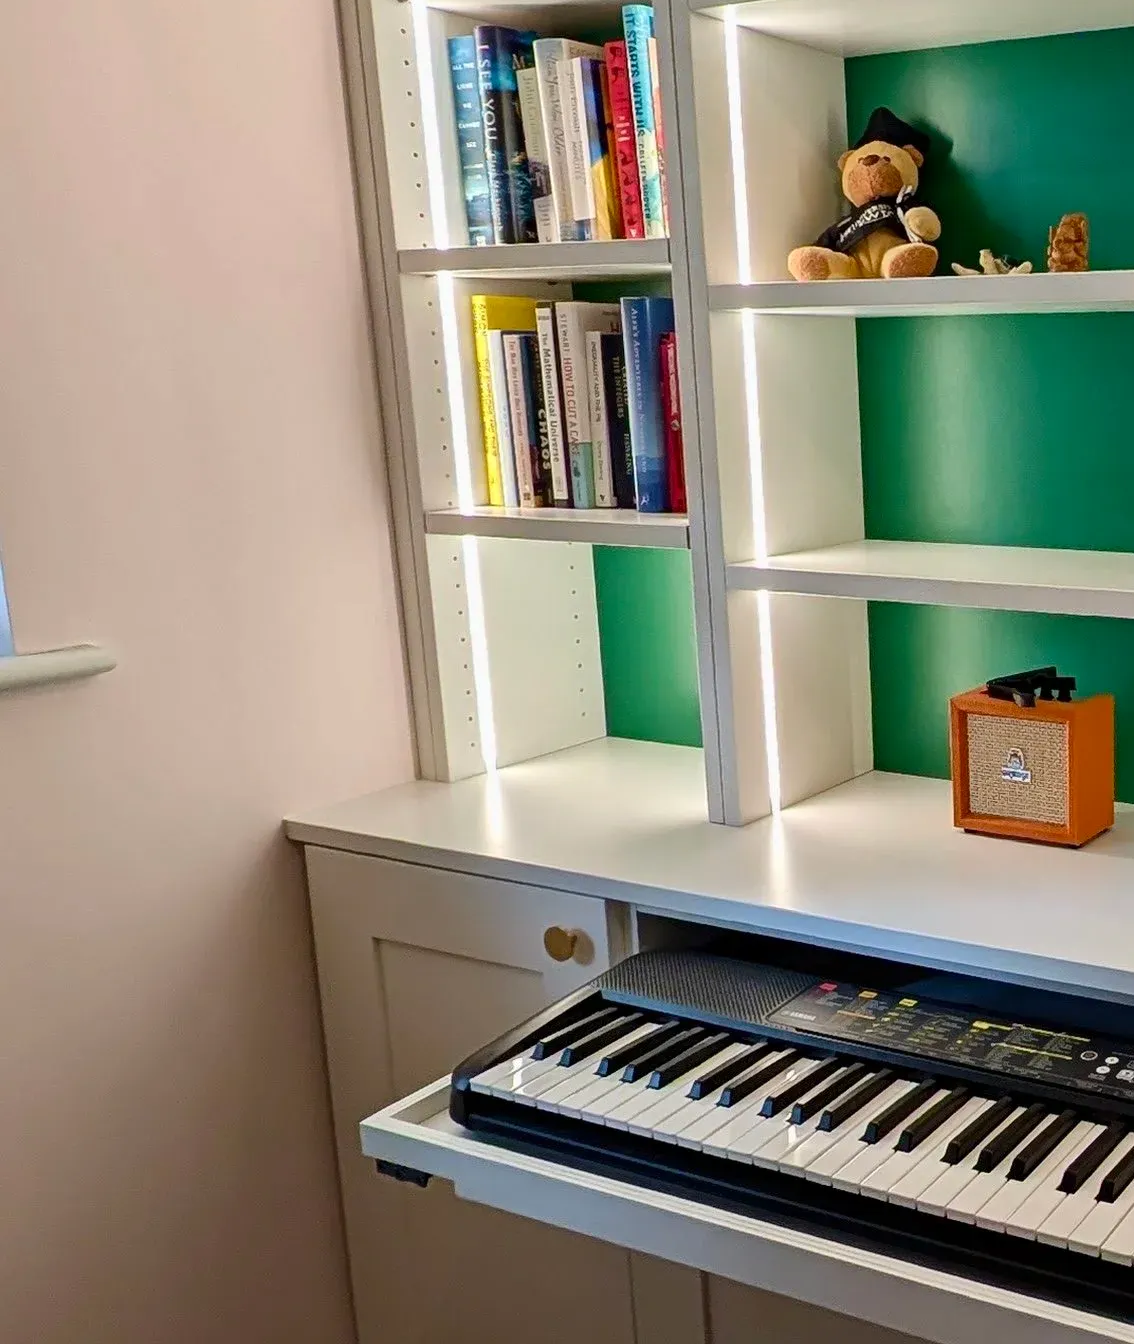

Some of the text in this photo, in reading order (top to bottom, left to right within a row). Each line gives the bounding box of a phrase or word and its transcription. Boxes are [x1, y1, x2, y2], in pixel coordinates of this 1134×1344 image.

[477, 59, 491, 91] SEE
[624, 13, 646, 136] IT STARTS WITH US
[481, 98, 497, 140] YOU
[560, 314, 569, 352] STEWART
[563, 357, 573, 382] HOW
[612, 356, 620, 373] THE
[543, 348, 556, 416] Mathematical
[550, 420, 559, 462] Universe
[565, 385, 574, 397] TO
[567, 399, 576, 418] CUT
[538, 409, 550, 469] CHAOS
[570, 430, 579, 456] CAKE
